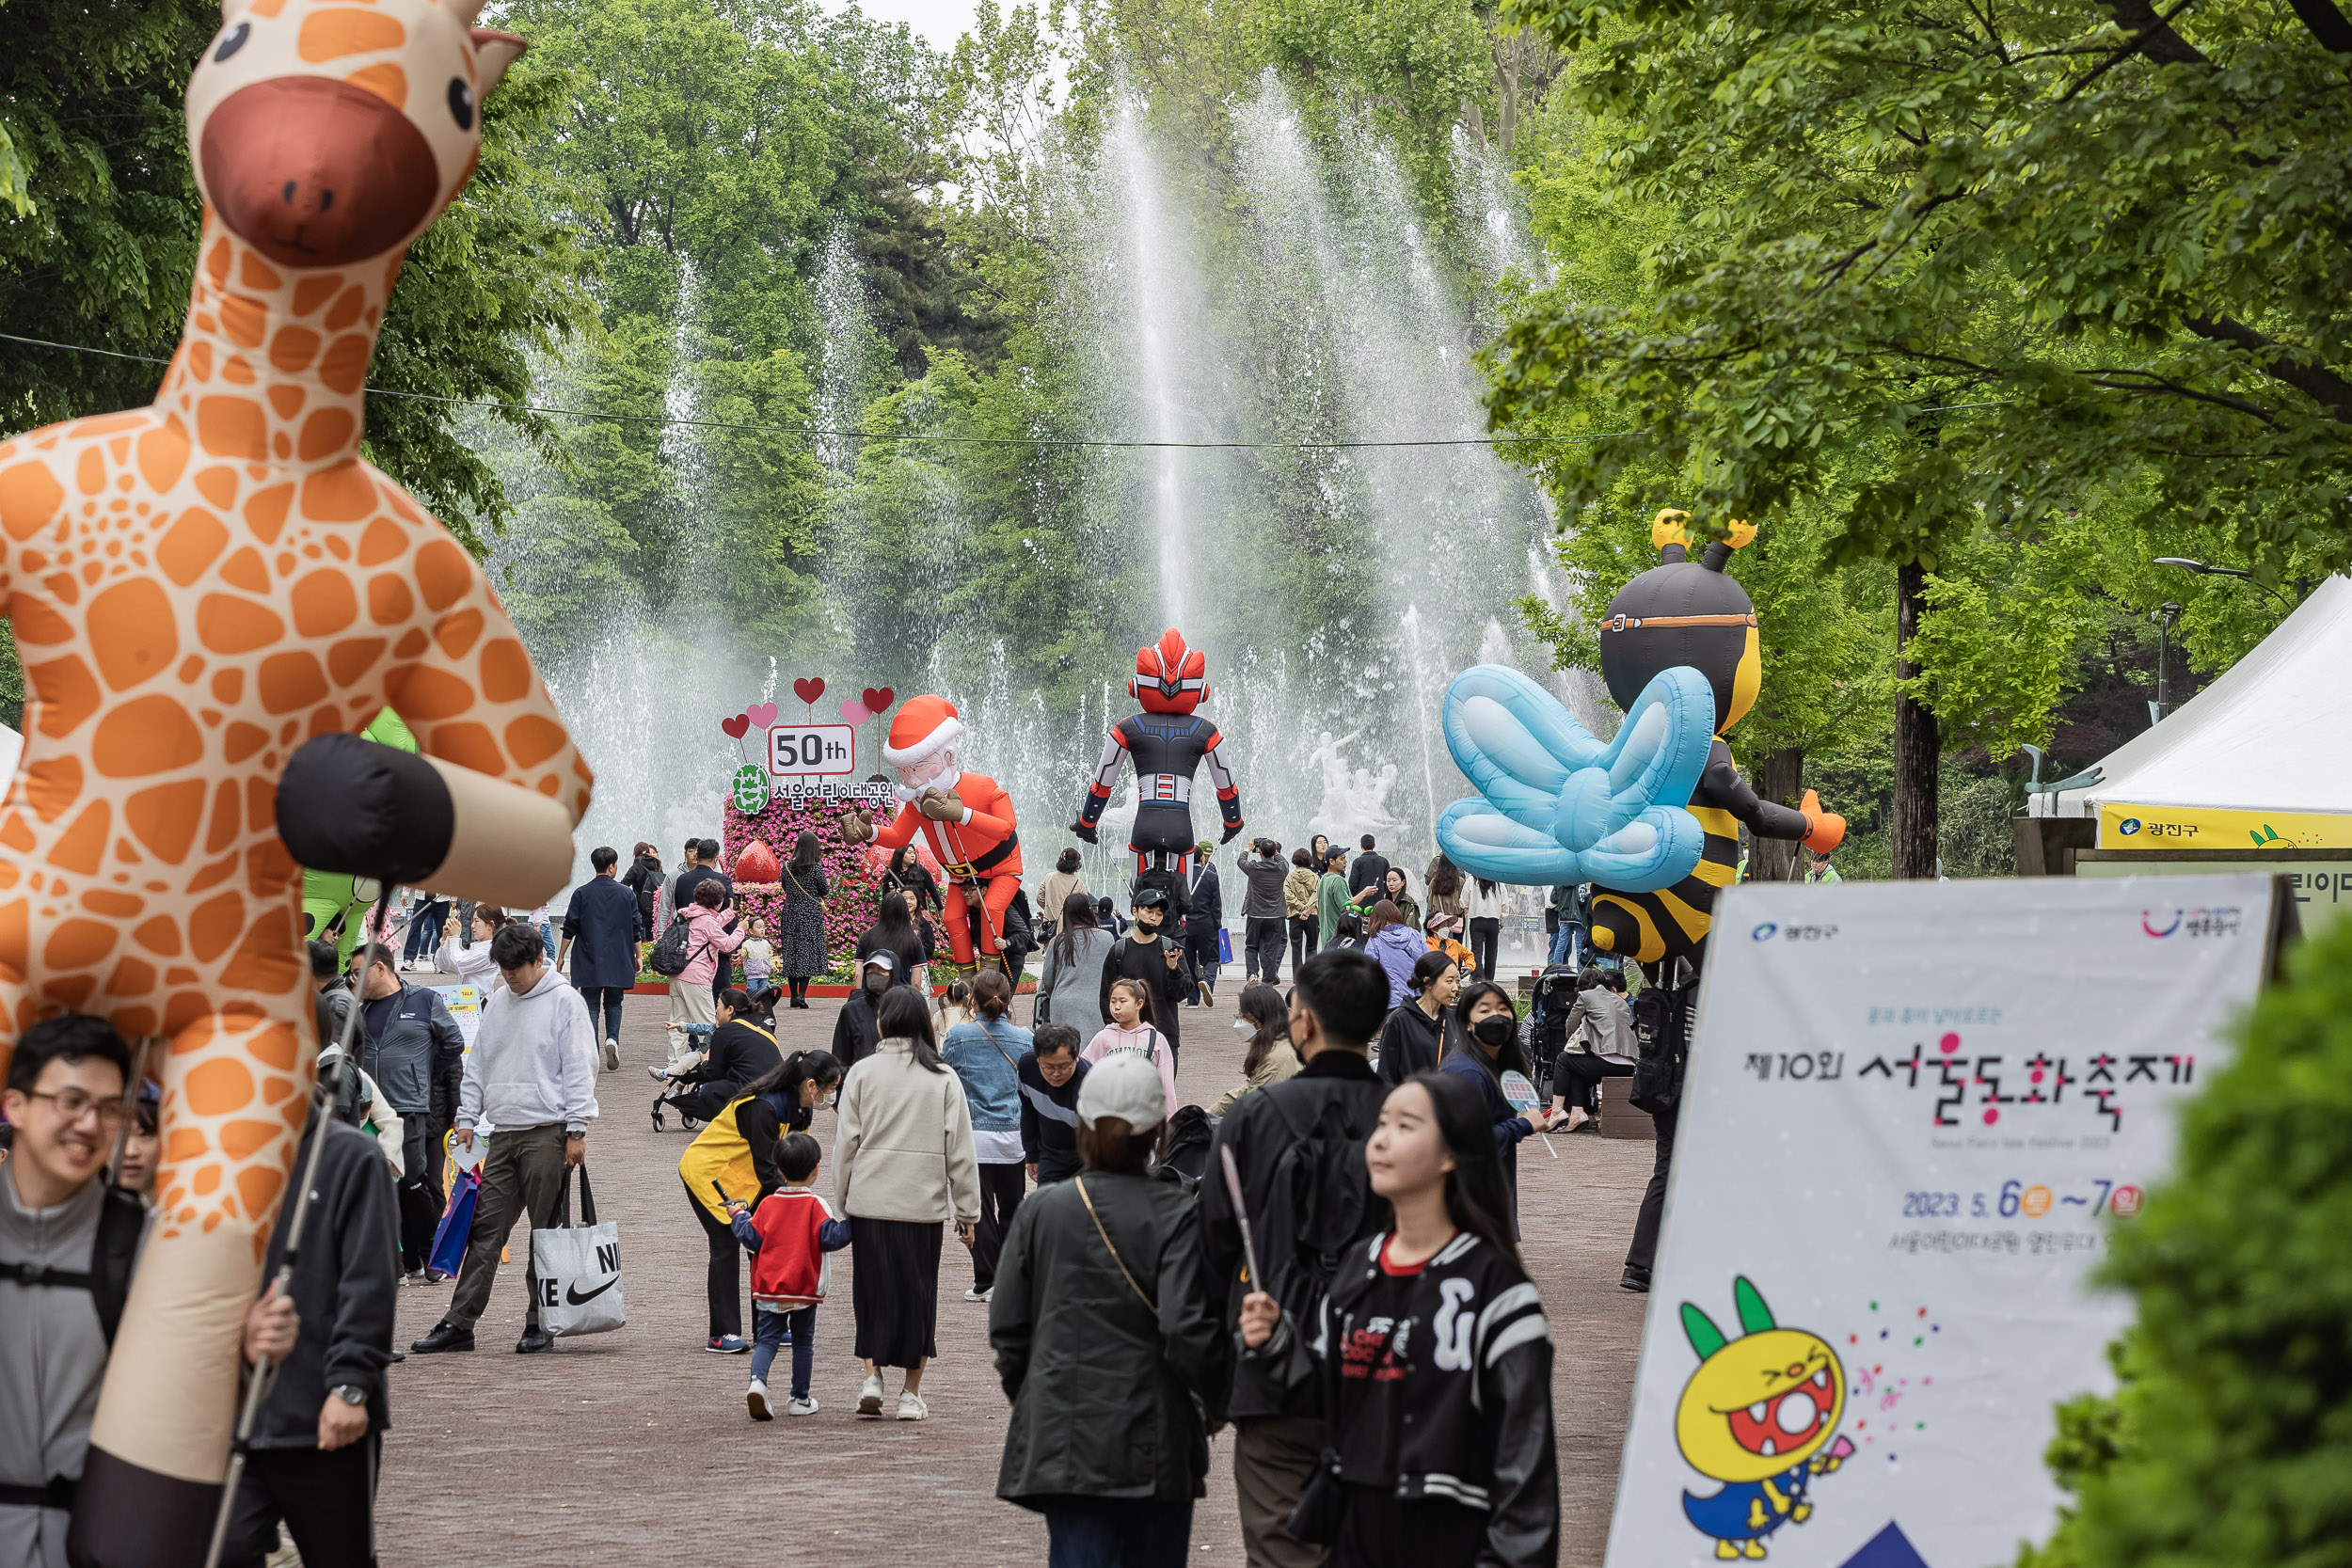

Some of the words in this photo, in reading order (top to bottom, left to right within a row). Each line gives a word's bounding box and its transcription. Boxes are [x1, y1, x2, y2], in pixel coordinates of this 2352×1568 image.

[777, 735, 847, 767] 50th
[774, 782, 895, 810] 서울어린이대공원
[2146, 822, 2200, 837] 광진구
[1744, 1052, 1843, 1082] 제10회
[1858, 1032, 2195, 1132] 서울동화축제
